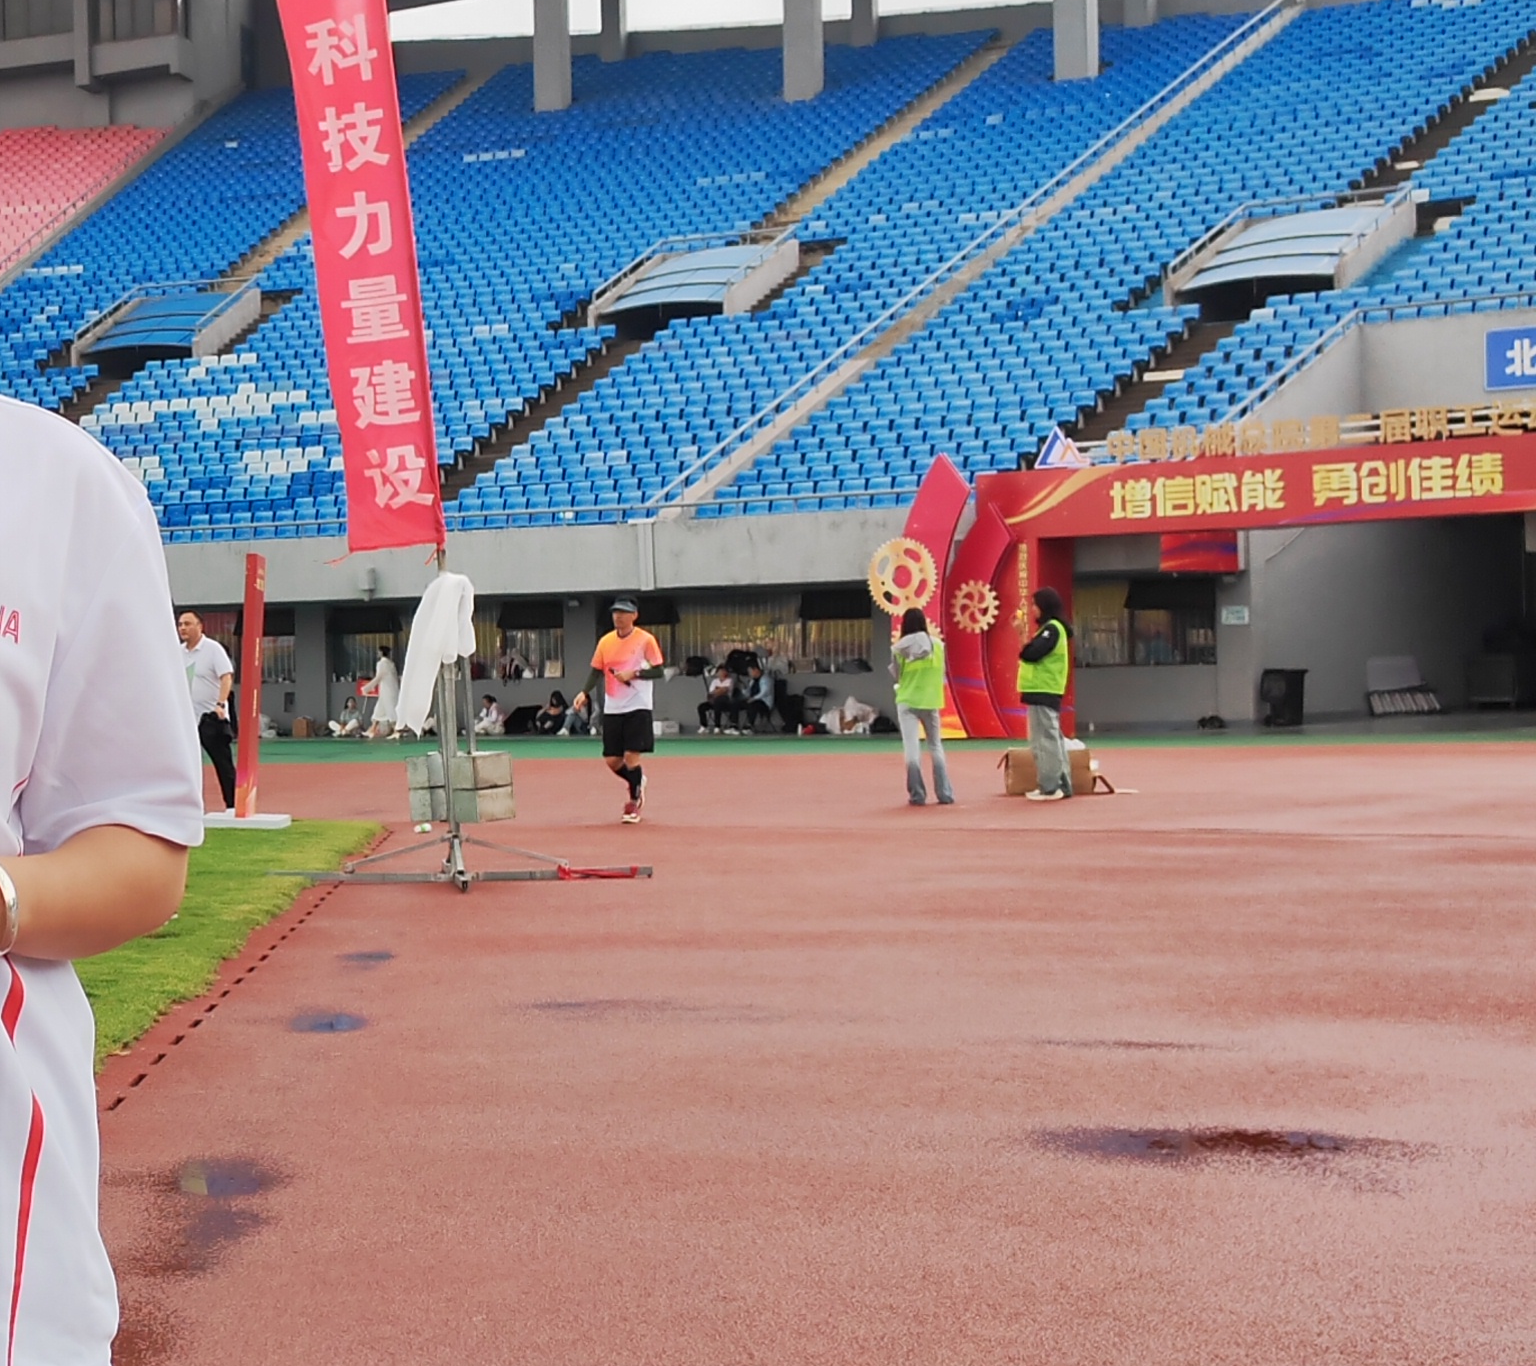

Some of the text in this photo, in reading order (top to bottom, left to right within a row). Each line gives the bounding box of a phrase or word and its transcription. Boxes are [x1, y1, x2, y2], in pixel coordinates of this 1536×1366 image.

[1107, 399, 1536, 463] 中国机械总院第二届职工运
[1108, 452, 1505, 520] 增信赋能 勇创佳绩
